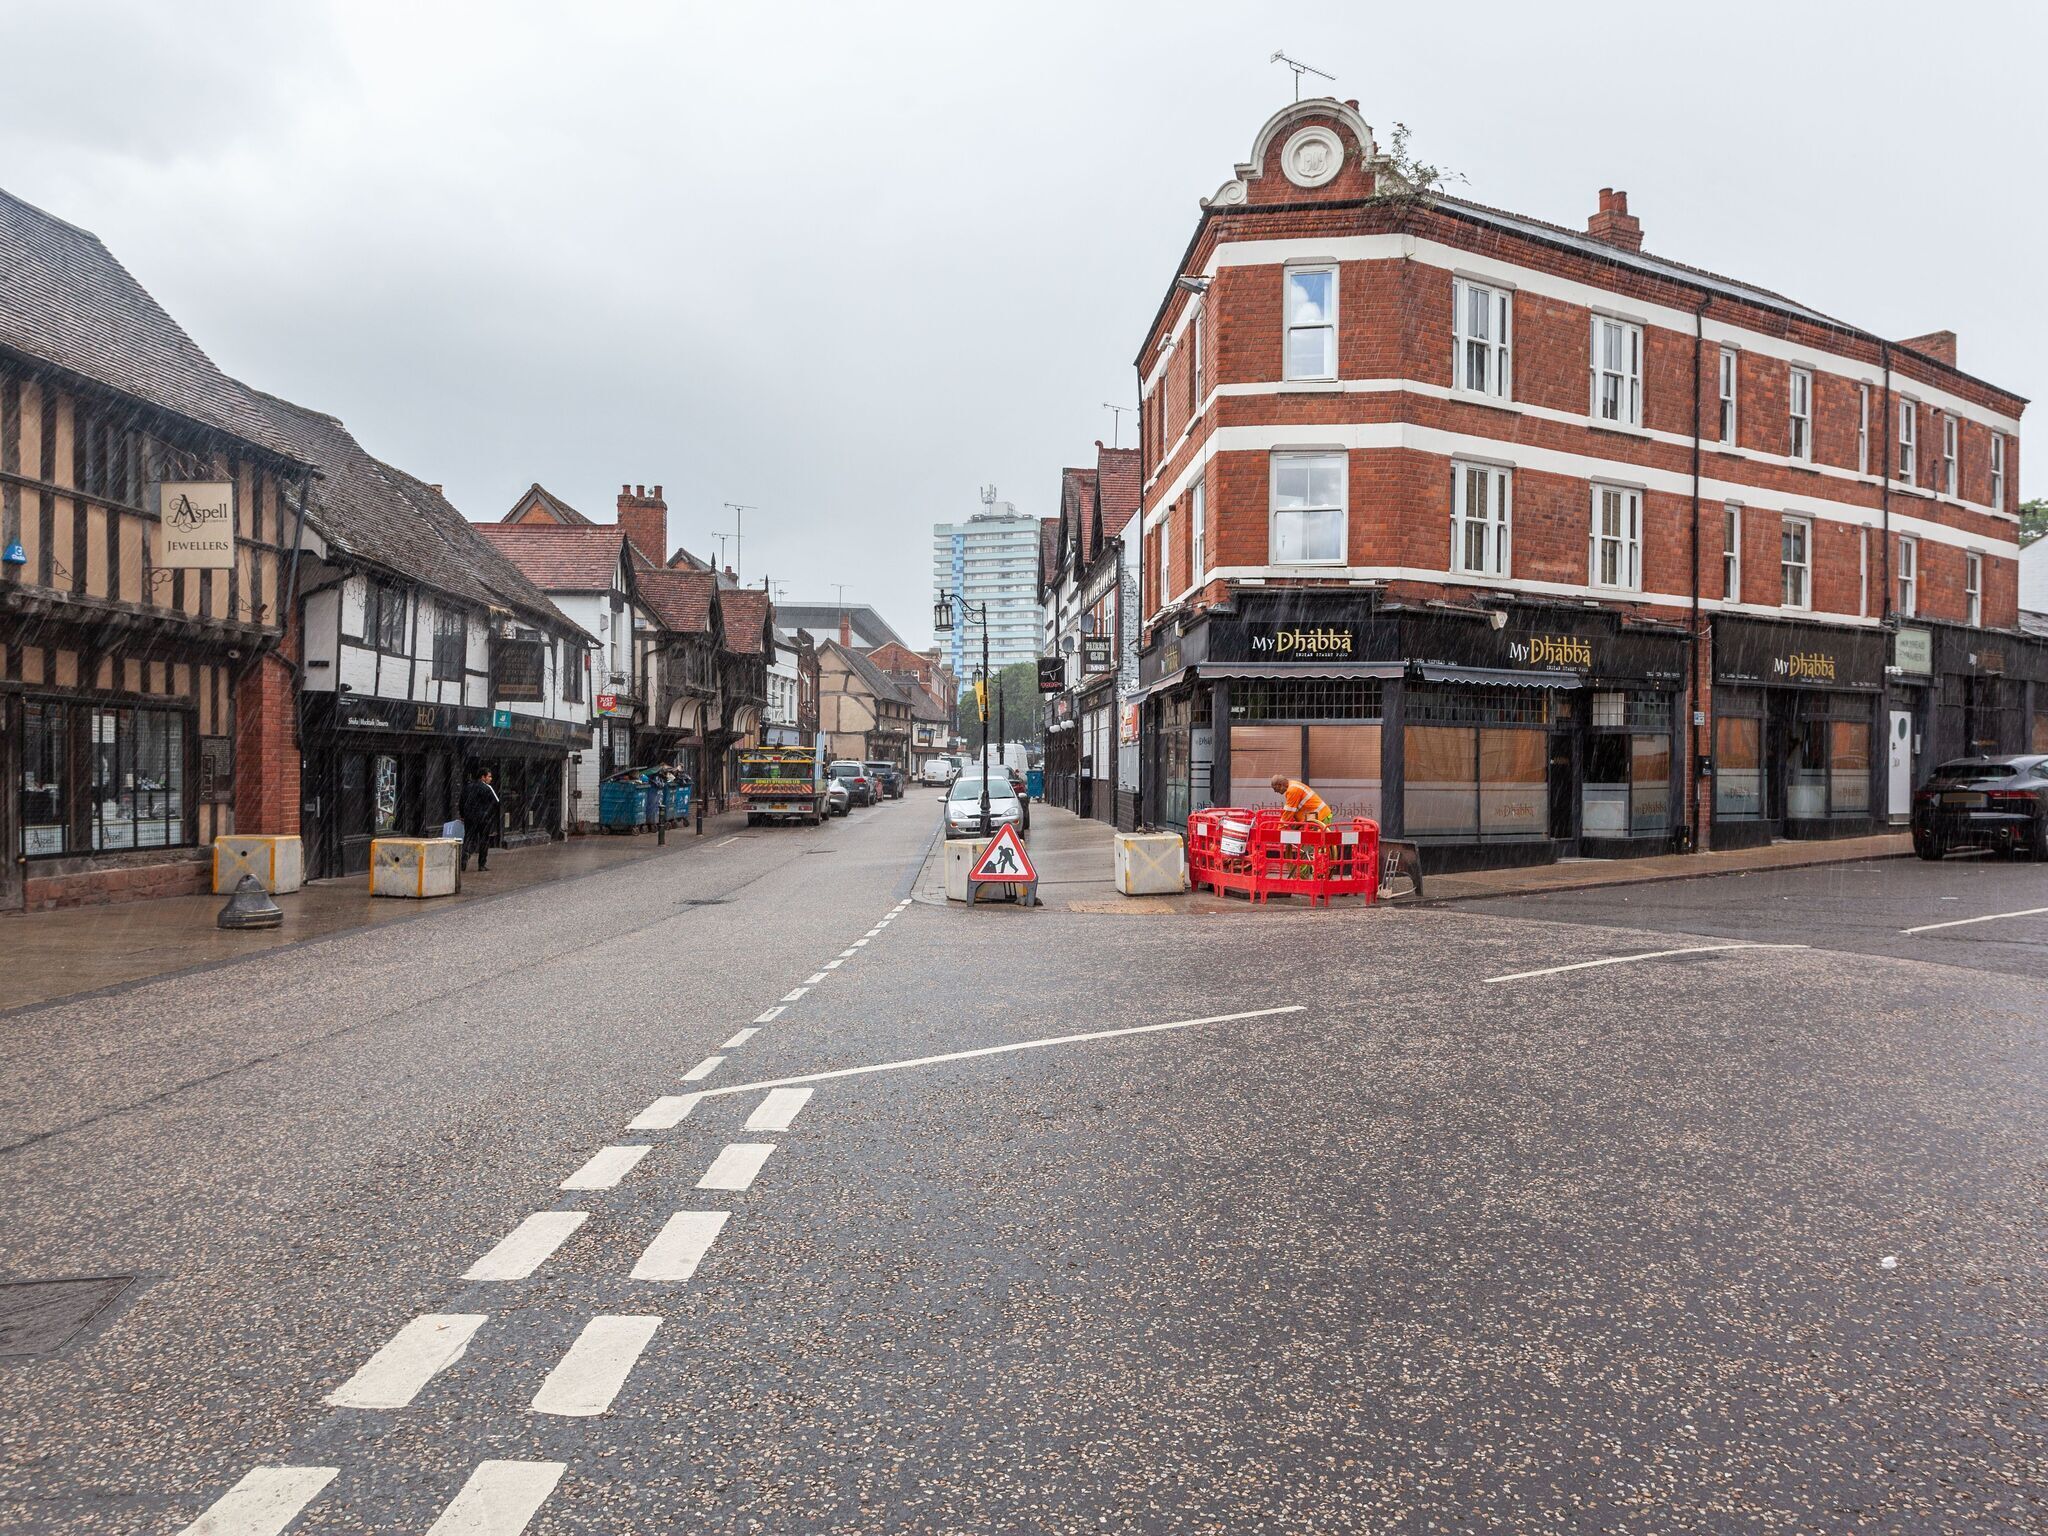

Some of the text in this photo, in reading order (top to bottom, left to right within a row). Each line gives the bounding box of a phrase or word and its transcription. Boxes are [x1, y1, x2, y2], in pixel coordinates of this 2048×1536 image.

[171, 494, 227, 524] Aspell
[168, 541, 229, 552] JEWELLERS
[1252, 628, 1352, 652] My Dhabba
[1509, 636, 1591, 667] My Dhabba
[1774, 652, 1835, 679] My Dhabba
